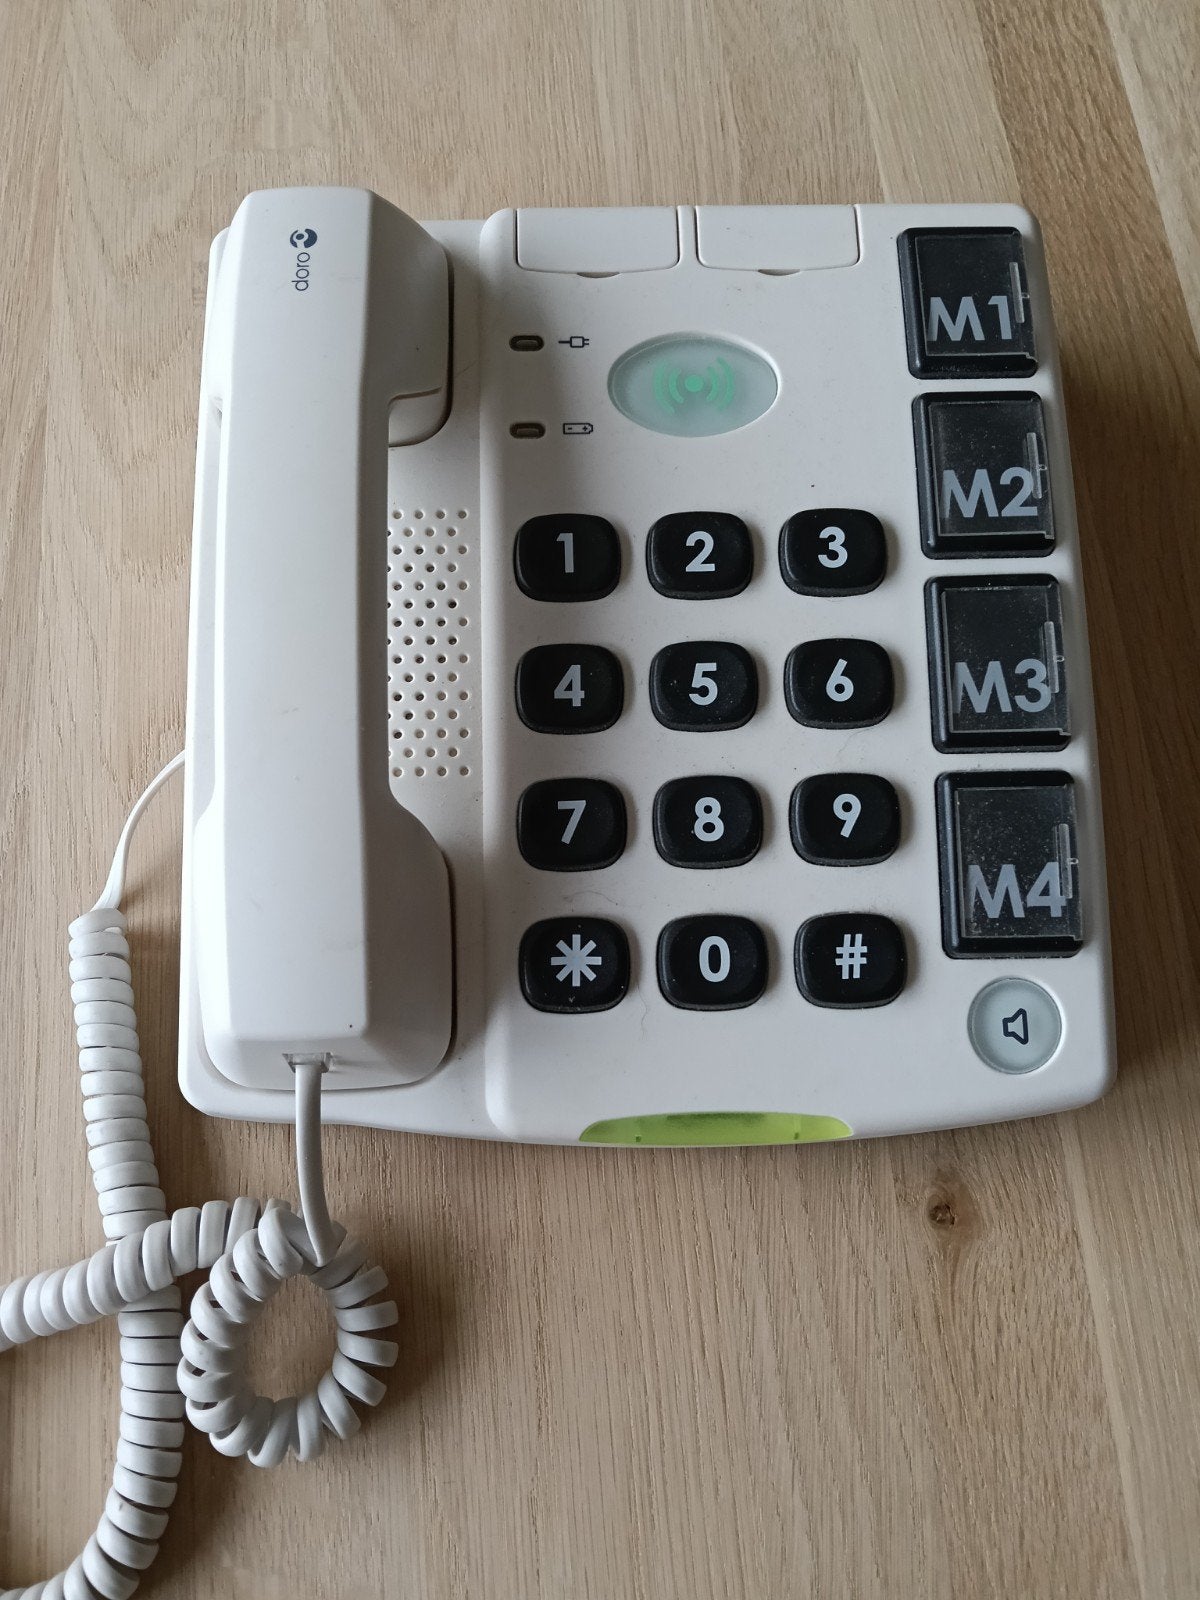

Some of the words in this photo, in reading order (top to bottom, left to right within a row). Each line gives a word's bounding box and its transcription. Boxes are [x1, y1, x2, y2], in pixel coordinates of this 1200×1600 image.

[292, 252, 310, 291] doro
[931, 296, 1012, 341] M1
[943, 466, 1038, 518] M2
[556, 533, 574, 573] 1
[686, 531, 715, 571] 2
[818, 527, 847, 568] 3
[553, 664, 585, 706] 4
[689, 663, 717, 705] 5
[826, 659, 853, 701] 6
[951, 658, 1052, 714] M3
[558, 800, 586, 843] 7
[694, 797, 724, 841] 8
[833, 794, 861, 837] 9
[968, 861, 1068, 919] M4
[700, 936, 730, 982] 0
